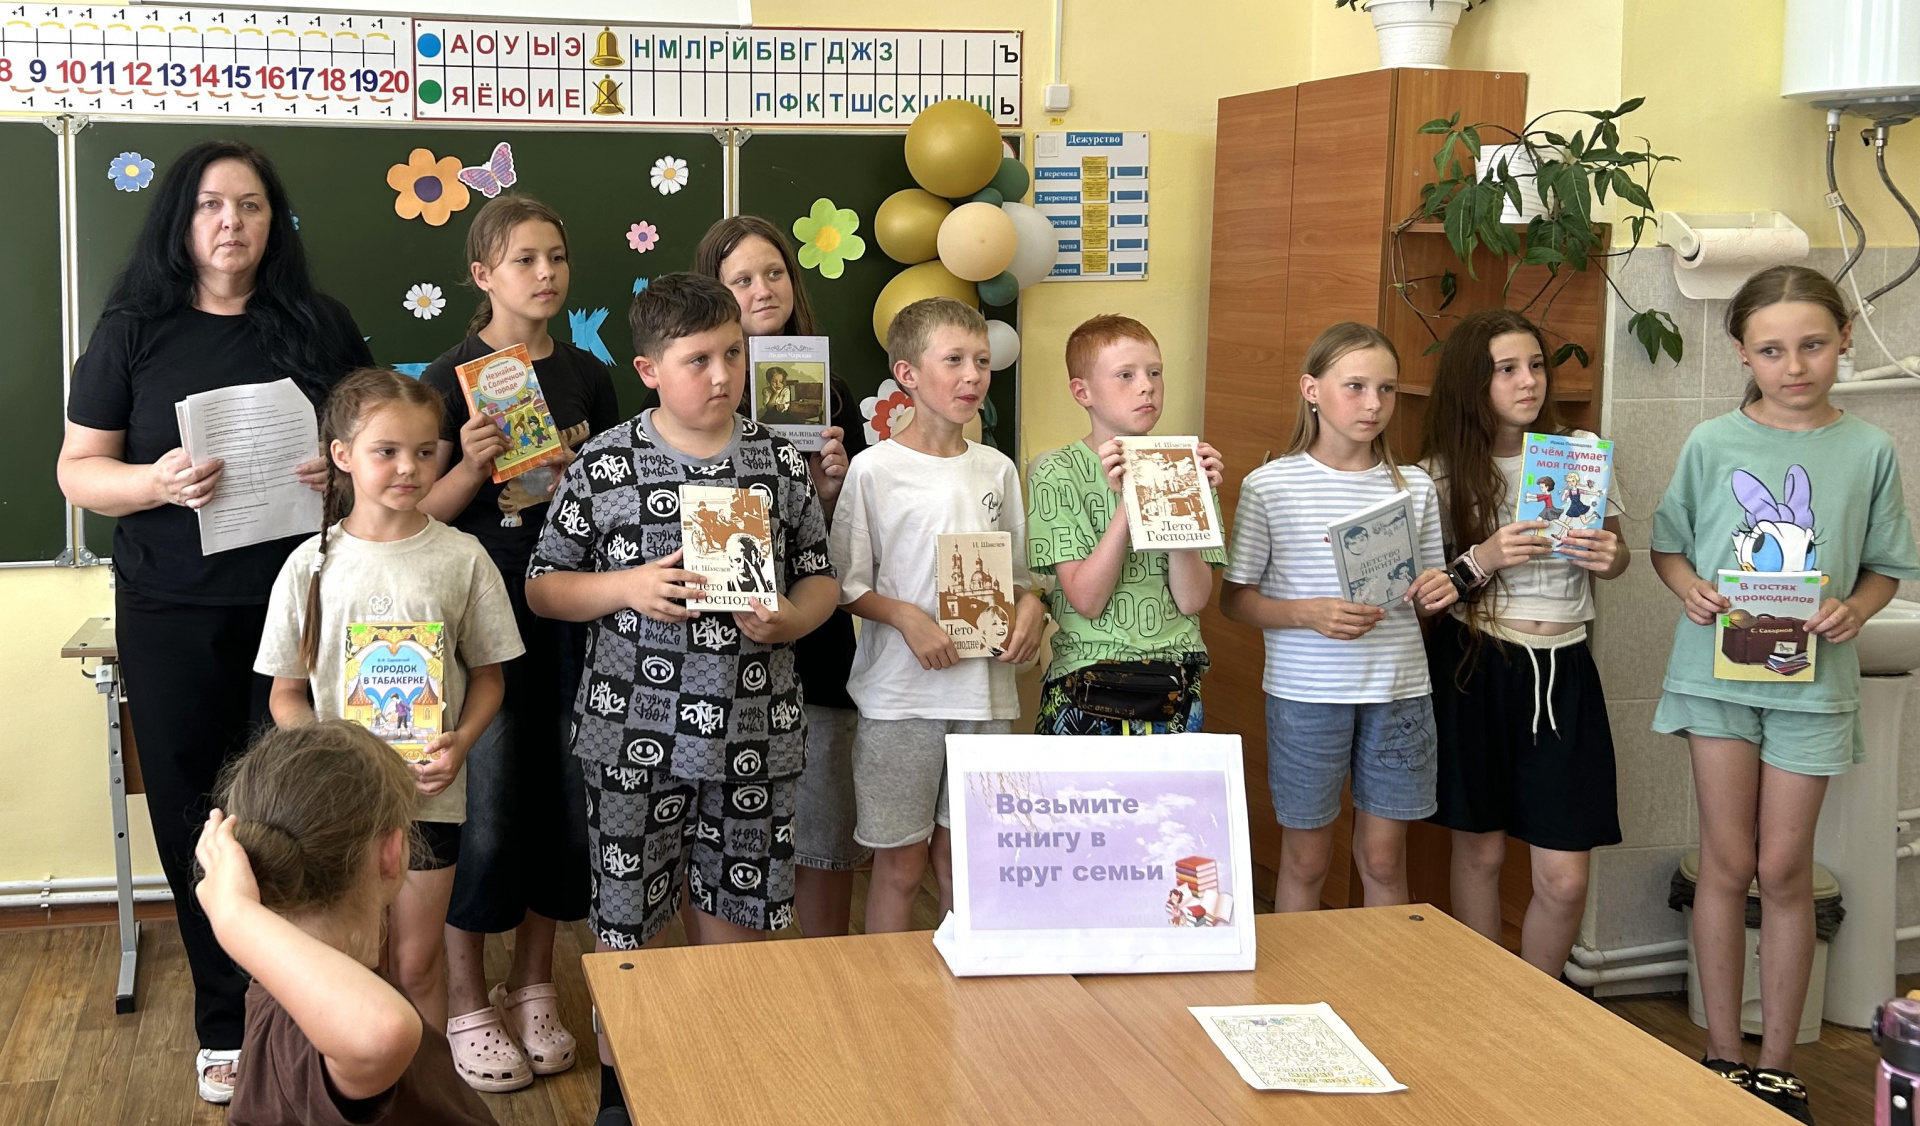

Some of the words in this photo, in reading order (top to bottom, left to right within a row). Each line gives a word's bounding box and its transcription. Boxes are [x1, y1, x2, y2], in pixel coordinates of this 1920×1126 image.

[12, 6, 24, 16] +1
[46, 7, 57, 17] +1
[80, 8, 92, 18] +1
[113, 9, 124, 20] +1
[146, 10, 158, 21] +1
[179, 11, 190, 22] +1
[212, 13, 223, 23] +1
[244, 14, 256, 24] +1
[277, 15, 288, 25] +1
[309, 16, 320, 26] +1
[341, 17, 351, 28] +1
[371, 19, 382, 29] +1
[451, 34, 468, 53] А
[477, 35, 494, 54] О
[504, 36, 519, 55] У
[534, 37, 555, 55] Ы
[565, 37, 581, 56] Э
[635, 39, 649, 58] Н
[660, 40, 676, 58] М
[685, 40, 700, 59] Л
[710, 41, 724, 59] Р
[733, 37, 747, 60] Й
[757, 42, 771, 60] Б
[781, 42, 795, 60] В
[805, 43, 817, 60] Г
[827, 42, 844, 64] Д
[852, 42, 872, 60] Ж
[880, 42, 892, 61] З
[1000, 45, 1018, 63] Ъ
[0, 59, 12, 82] 8
[30, 60, 46, 83] 9
[57, 60, 86, 84] 10
[91, 61, 114, 84] 11
[123, 62, 152, 85] 12
[157, 63, 186, 86] 13
[190, 64, 220, 87] 14
[222, 65, 251, 88] 15
[256, 66, 284, 89] 16
[286, 67, 314, 90] 17
[318, 68, 346, 91] 18
[351, 69, 378, 92] 19
[379, 70, 409, 93] 20
[22, 96, 33, 106] -1
[55, 97, 66, 108] -1
[90, 98, 100, 108] -1
[121, 99, 132, 109] -1
[154, 100, 165, 110] -1
[187, 101, 198, 111] -1
[218, 102, 229, 112] -1
[251, 103, 262, 113] -1
[285, 104, 296, 113] -1
[316, 104, 326, 114] -1
[347, 105, 357, 115] -1
[381, 106, 391, 116] -1
[452, 87, 468, 105] Я
[478, 83, 492, 106] Ё
[502, 88, 525, 107] Ю
[539, 89, 553, 107] И
[566, 89, 580, 108] Е
[757, 93, 770, 111] П
[780, 93, 798, 111] Ф
[807, 94, 820, 112] К
[830, 94, 843, 112] Т
[852, 94, 872, 112] Ш
[879, 94, 893, 113] С
[901, 95, 916, 112] Х
[1001, 97, 1014, 115] Ь
[1068, 132, 1120, 145] Дежурство
[486, 365, 517, 380] Незнайка
[488, 371, 525, 388] Солнечном
[495, 382, 518, 395] городе
[1529, 445, 1538, 454] О
[1542, 447, 1563, 456] чём
[1566, 451, 1608, 462] думает
[1536, 460, 1559, 469] моя
[1563, 462, 1601, 473] голова
[1161, 521, 1192, 532] Лето
[1146, 531, 1211, 542] Господне
[1360, 549, 1400, 569] ДЕТСТВО
[1735, 595, 1814, 603] крокодилов
[692, 616, 737, 651] KING
[945, 624, 973, 635] Лето
[372, 665, 417, 674] ГОРОДОК
[373, 676, 424, 684] ТАБАКЕРКЕ
[590, 681, 627, 716] KING
[996, 794, 1139, 814] Возьмите
[998, 832, 1081, 853] книгу
[1091, 832, 1106, 847] в
[602, 842, 640, 877] KING
[1000, 865, 1063, 887] круг
[1073, 865, 1163, 881] семьи
